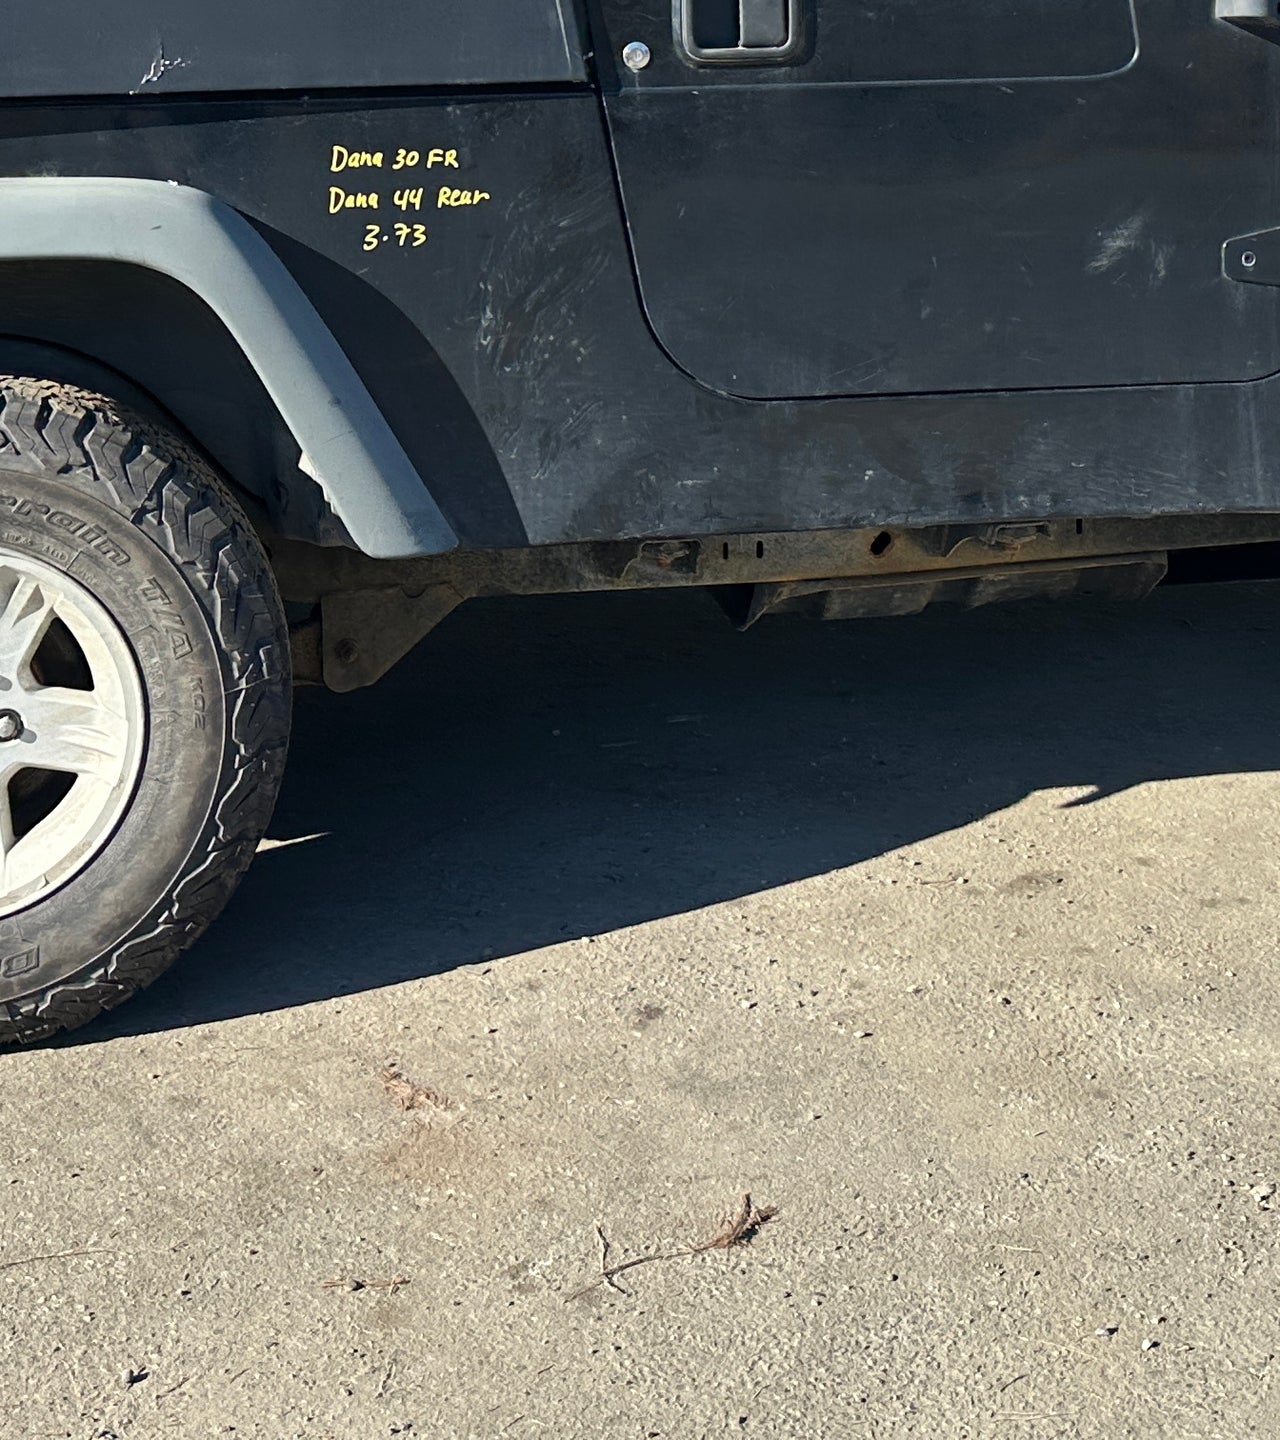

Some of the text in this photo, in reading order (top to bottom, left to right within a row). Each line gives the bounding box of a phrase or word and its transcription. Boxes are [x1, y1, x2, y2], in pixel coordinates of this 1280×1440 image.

[330, 145, 459, 172] Dana 30 FR
[328, 186, 491, 214] Dana 44 Rear
[362, 222, 427, 251] 3.73
